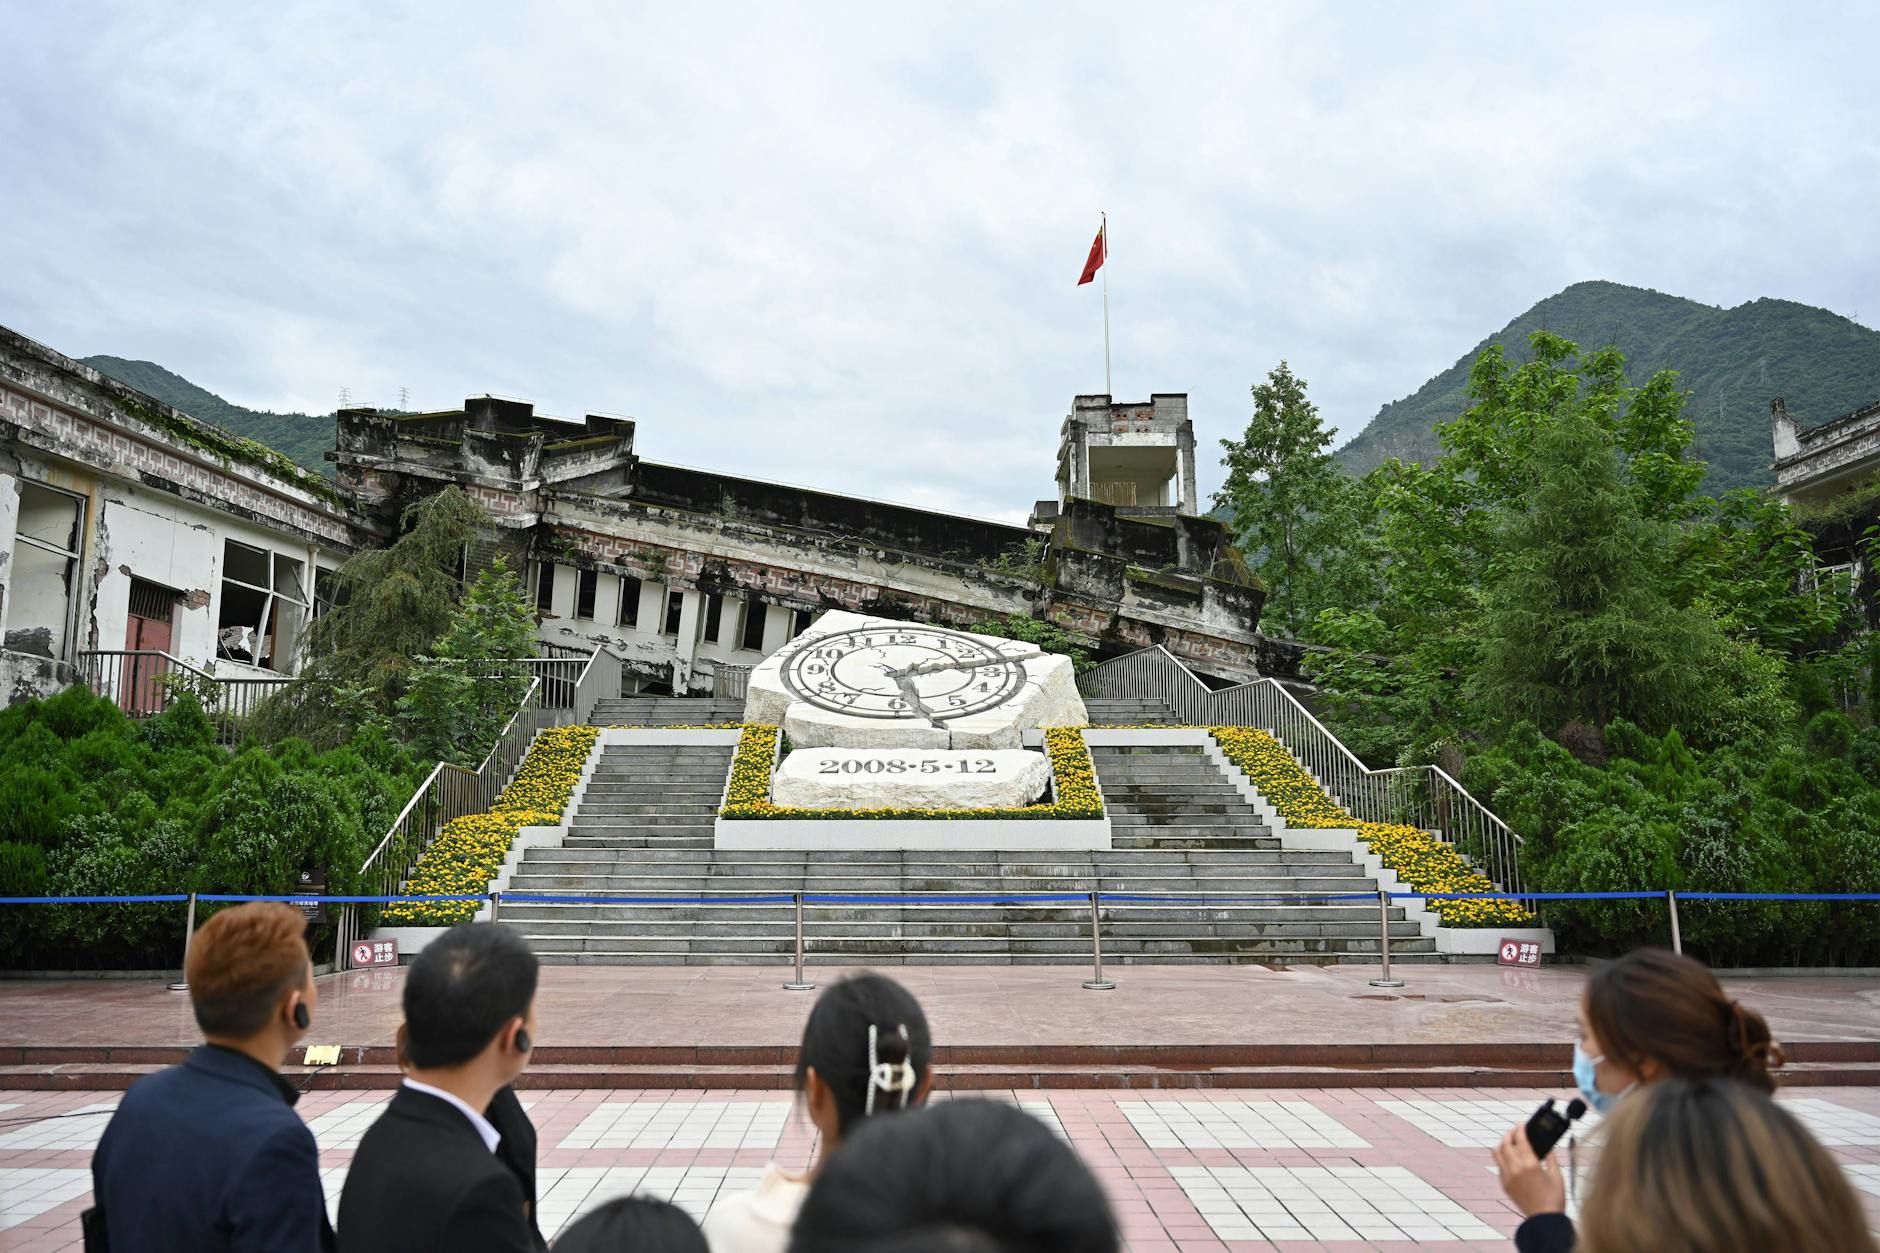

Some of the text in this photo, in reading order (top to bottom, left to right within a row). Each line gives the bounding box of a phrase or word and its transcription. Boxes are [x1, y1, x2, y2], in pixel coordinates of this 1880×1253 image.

[888, 634, 917, 644] 12
[936, 639, 951, 649] 1
[814, 648, 844, 660] 10
[958, 647, 976, 659] 2
[807, 664, 825, 675] 9
[983, 667, 1001, 678] 3
[818, 681, 836, 693] 8
[972, 682, 991, 693] 4
[888, 698, 907, 710] 6
[948, 695, 967, 706] 5
[373, 942, 393, 953] 游客
[1520, 943, 1539, 954] 游客
[375, 953, 393, 962] 止步
[1518, 954, 1537, 963] 止步
